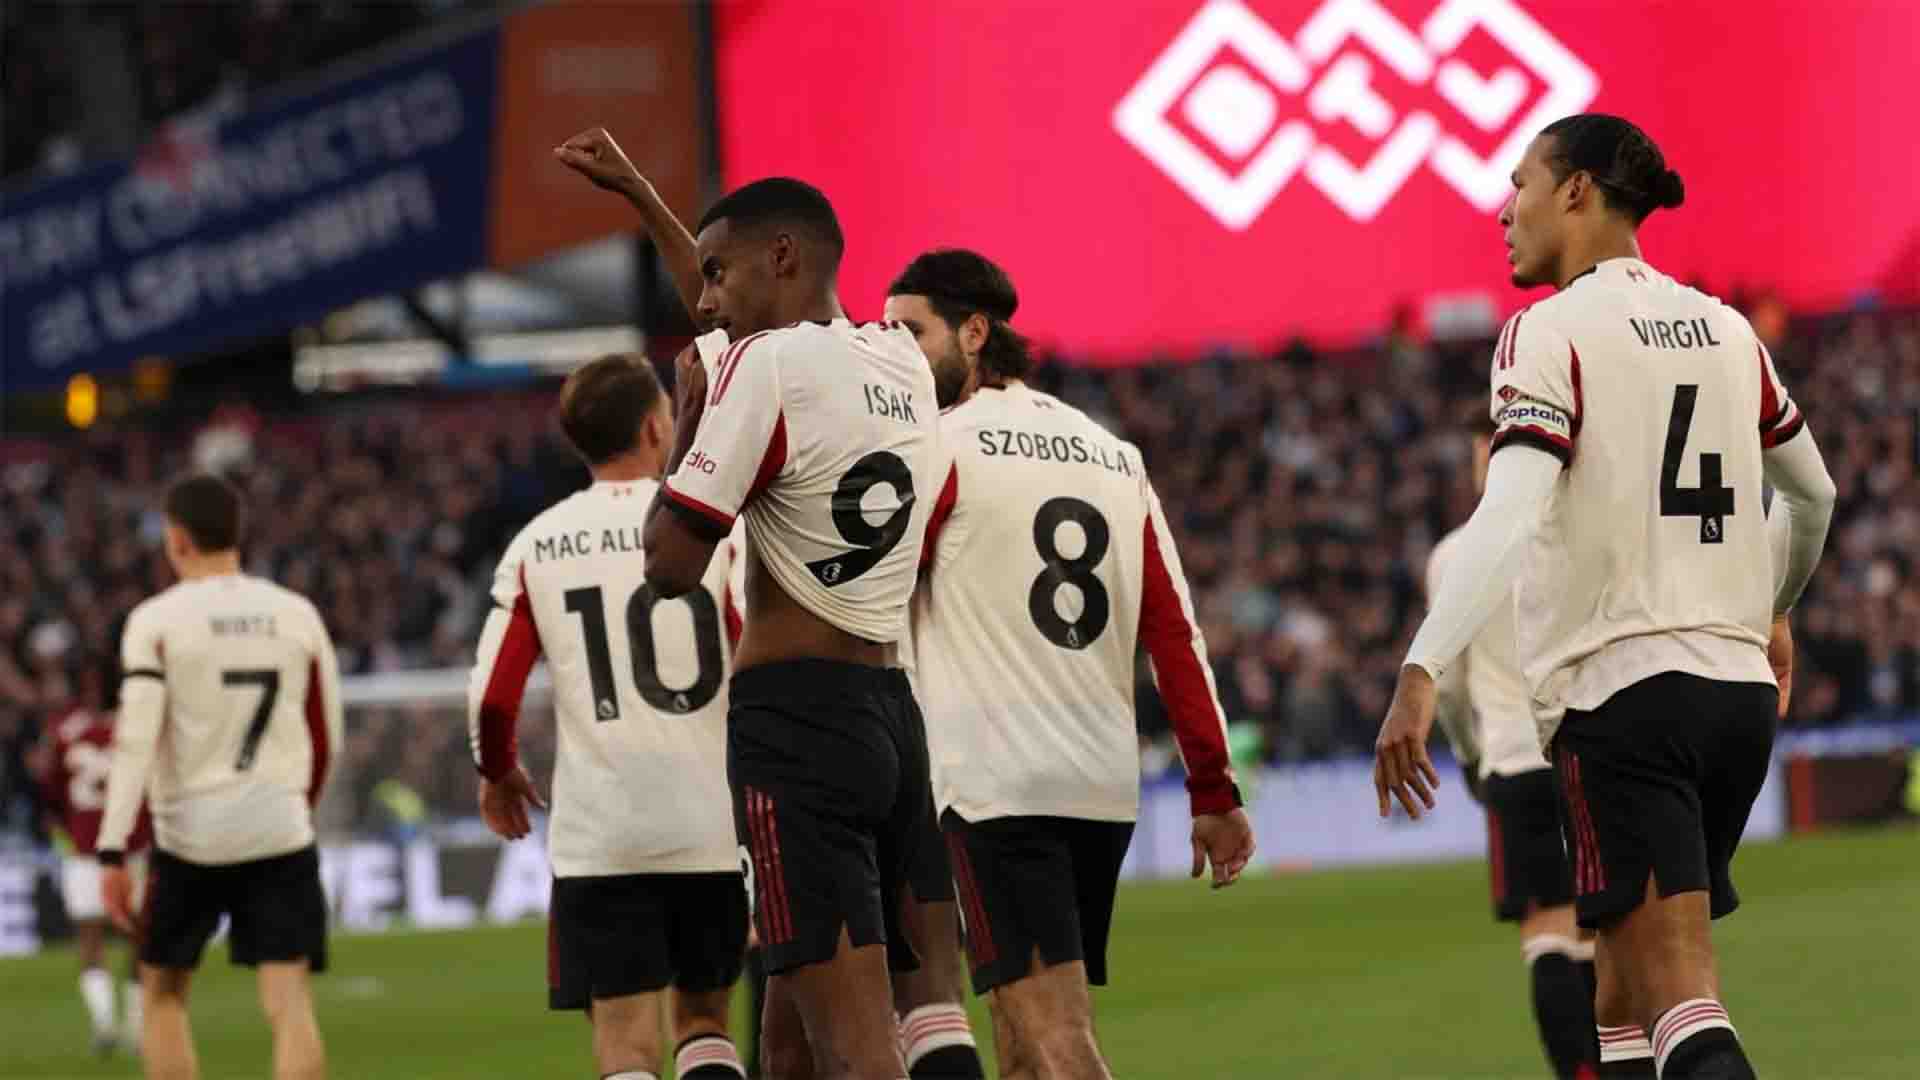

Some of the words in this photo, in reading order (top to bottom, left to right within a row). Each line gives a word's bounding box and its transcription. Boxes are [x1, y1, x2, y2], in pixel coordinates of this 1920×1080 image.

[1630, 317, 1721, 350] VIRGIL
[863, 383, 918, 424] ISAK
[1502, 405, 1566, 428] captain
[978, 429, 1139, 478] SZOBOSZLA
[1660, 384, 1735, 544] 4
[534, 530, 592, 563] MAC
[804, 450, 917, 588] 9
[1029, 497, 1109, 651] 8
[563, 582, 723, 722] 10
[221, 669, 280, 772] 7
[322, 838, 550, 930] ELA
